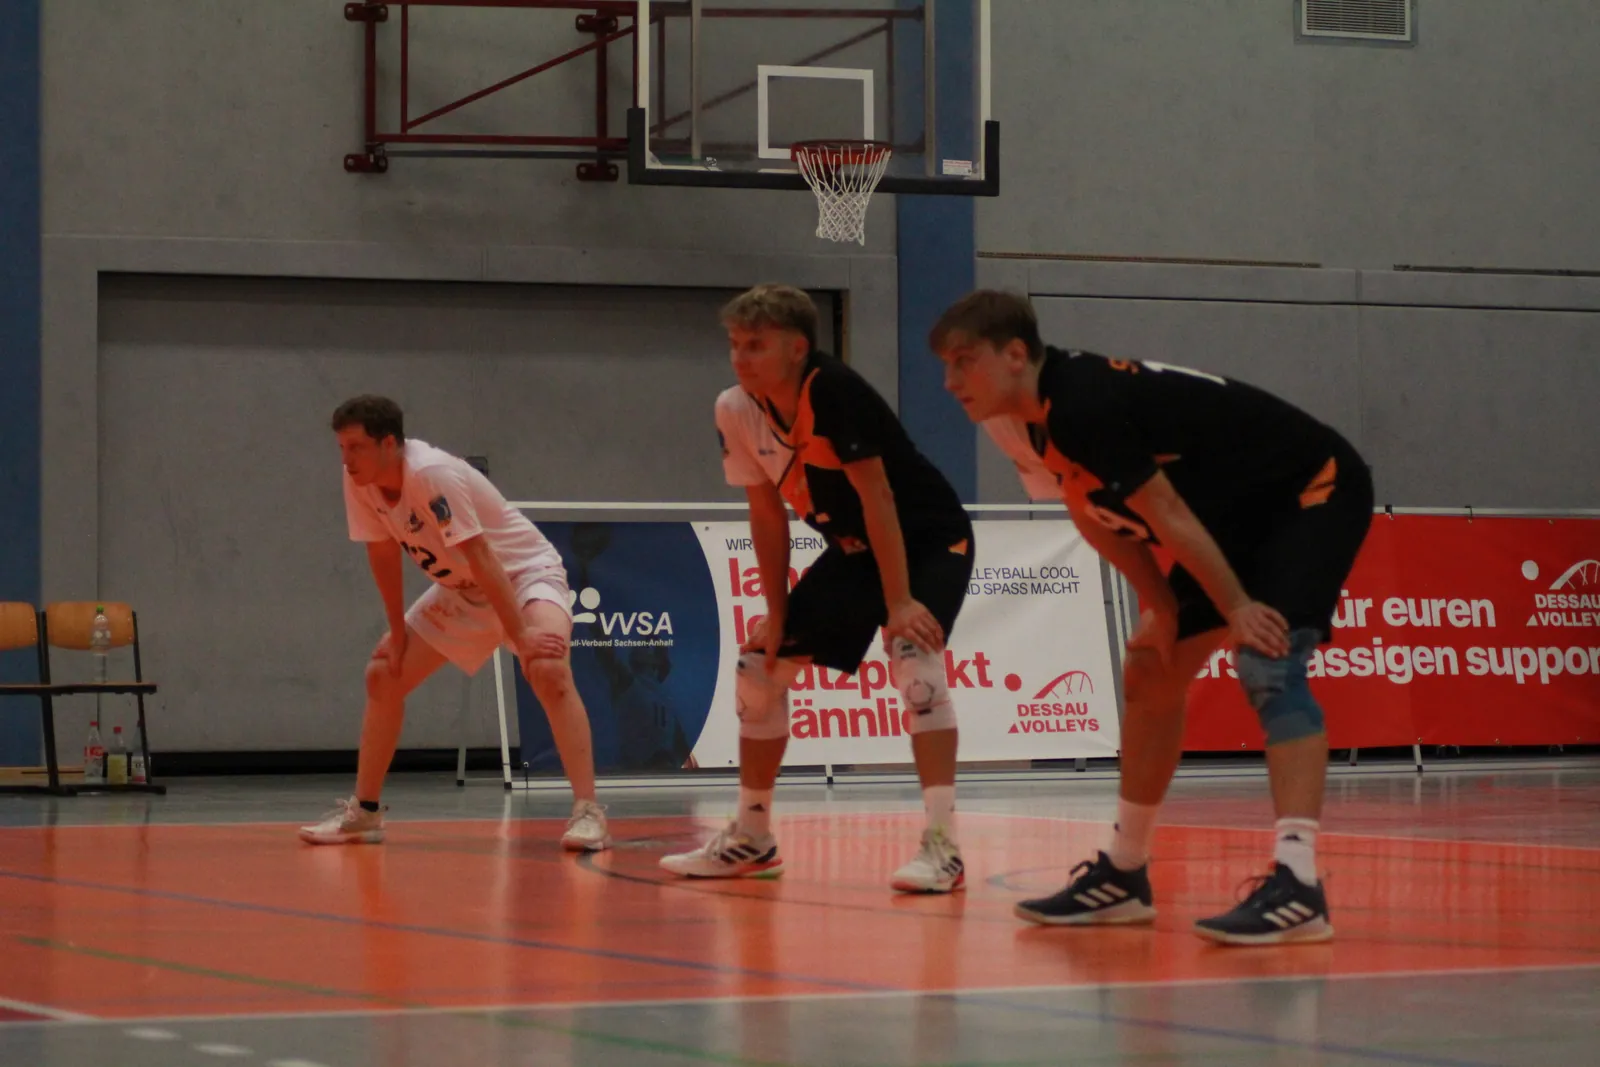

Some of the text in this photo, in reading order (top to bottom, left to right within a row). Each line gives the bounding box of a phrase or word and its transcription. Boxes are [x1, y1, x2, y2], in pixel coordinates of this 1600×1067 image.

[725, 538, 753, 551] WIR
[1040, 566, 1079, 579] COOL
[984, 582, 1028, 595] SPASS
[1031, 581, 1081, 594] MACHT
[1535, 593, 1600, 609] DESSAU
[1382, 597, 1496, 628] euren
[599, 611, 673, 636] VVSA
[614, 638, 674, 647] Sachsen-Anhalt
[1017, 702, 1088, 717] DESSAU
[1020, 718, 1100, 734] VOLLEYS
